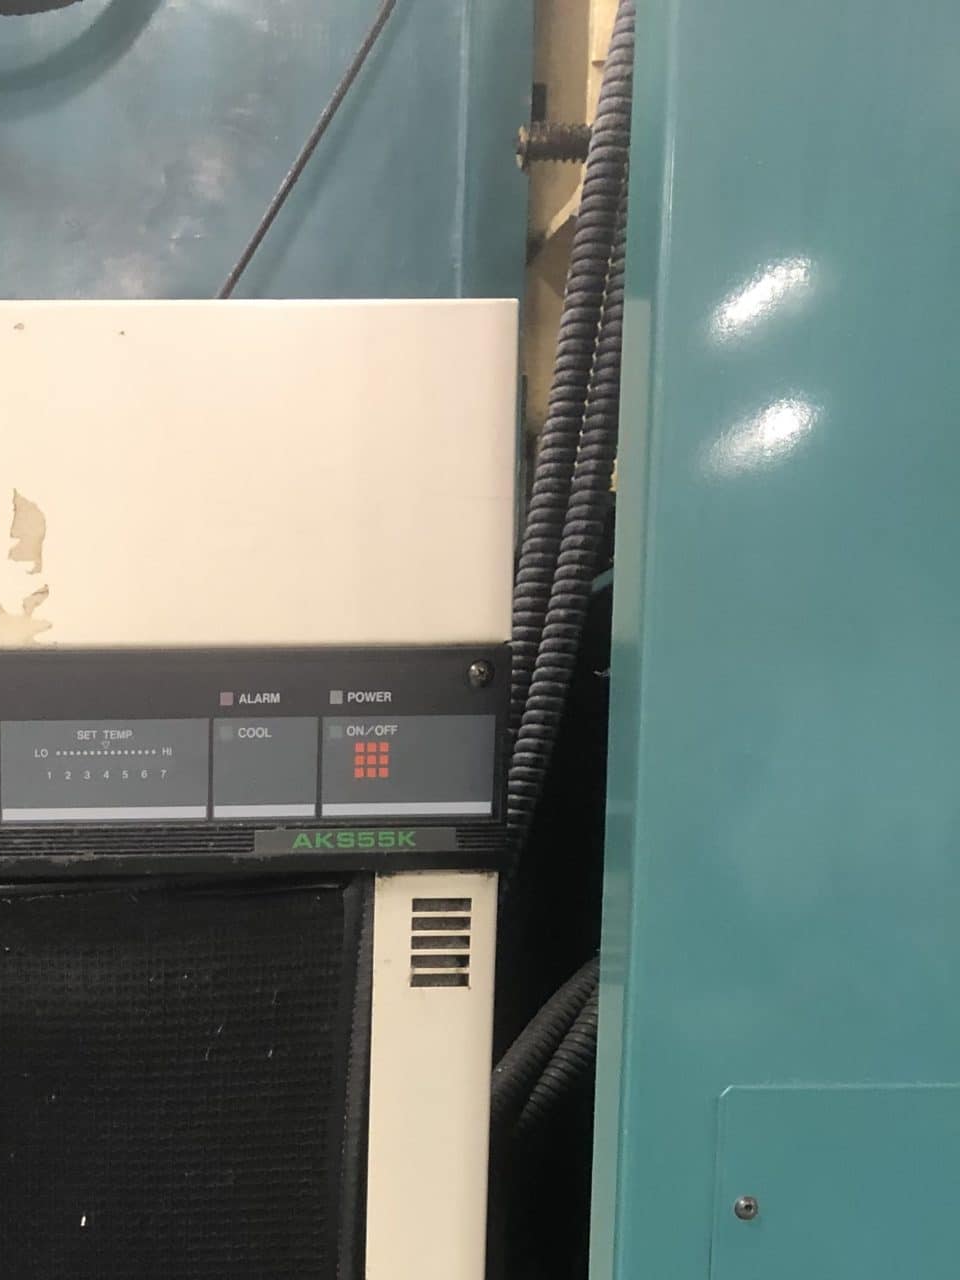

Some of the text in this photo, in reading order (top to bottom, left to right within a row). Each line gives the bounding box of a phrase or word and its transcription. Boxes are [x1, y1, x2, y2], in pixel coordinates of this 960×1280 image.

[239, 692, 281, 704] ALARM
[347, 691, 392, 703] POWER
[76, 729, 133, 740] SET TEMP
[238, 727, 273, 738] COOL
[346, 725, 398, 737] ON/OFF
[34, 748, 49, 758] LO
[161, 746, 173, 756] HI
[64, 770, 72, 780] 2
[83, 770, 91, 780] 3
[103, 770, 110, 779] 4
[122, 770, 129, 779] 5
[140, 769, 148, 779] 6
[160, 769, 167, 779] 7
[292, 830, 417, 849] AKS55K
